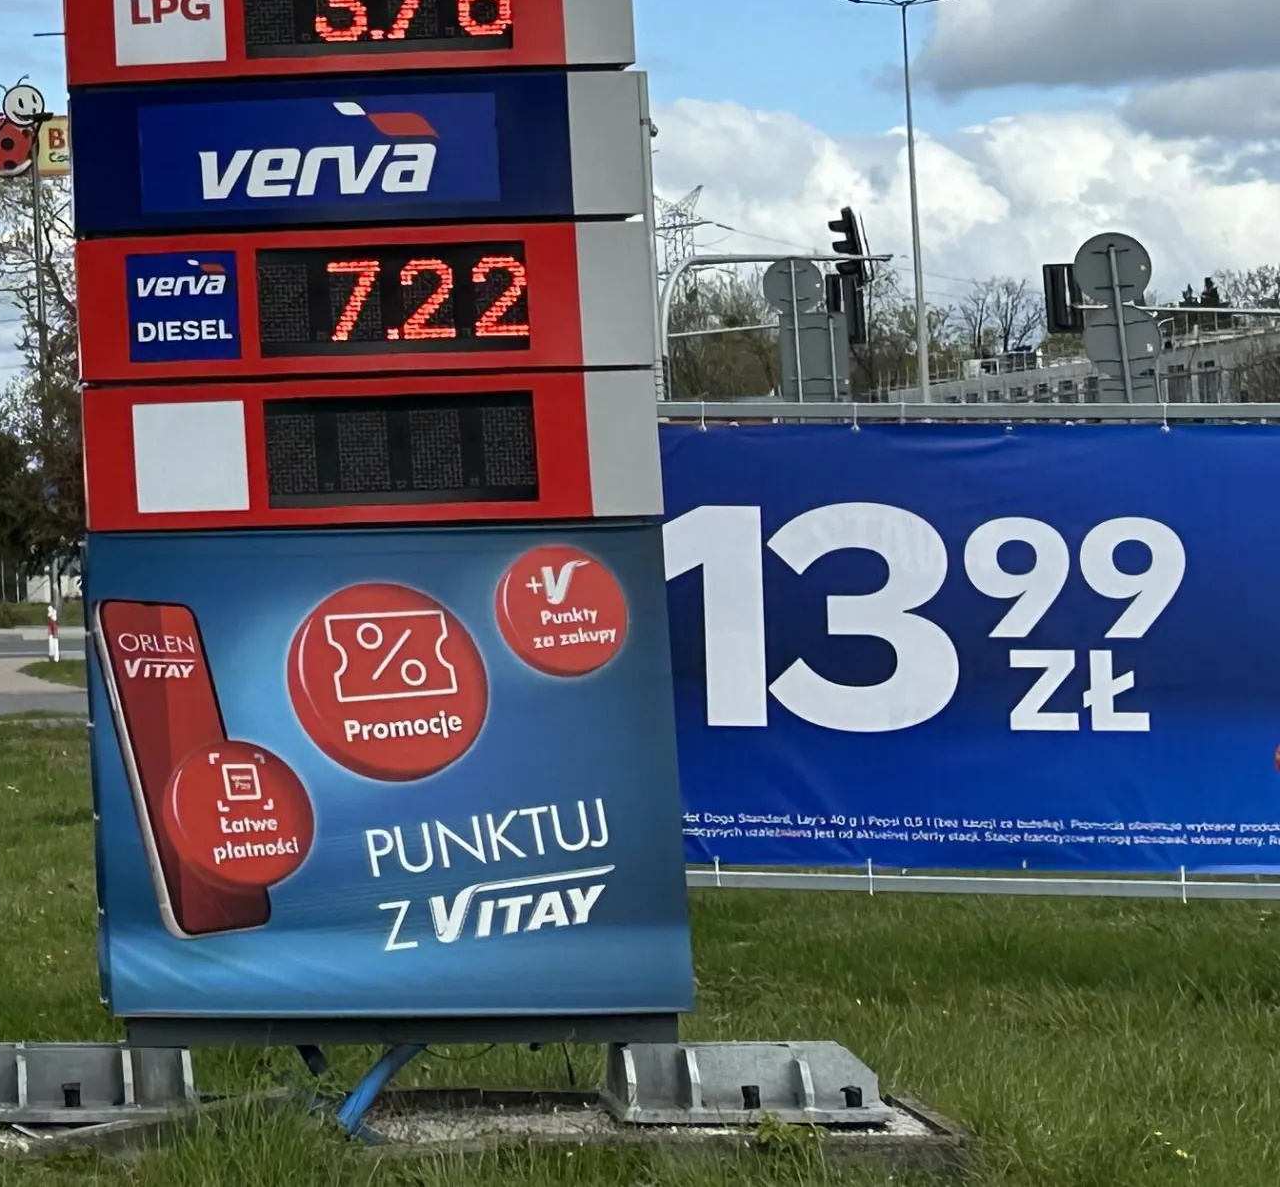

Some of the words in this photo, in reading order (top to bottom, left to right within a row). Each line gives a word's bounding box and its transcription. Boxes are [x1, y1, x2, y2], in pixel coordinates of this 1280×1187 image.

[199, 141, 438, 200] verva
[136, 273, 226, 297] verva
[327, 256, 529, 342] 7.22
[137, 319, 233, 343] DIESEL
[540, 607, 598, 626] Punkty
[118, 632, 195, 655] ORLEN
[533, 635, 555, 649] za
[559, 626, 617, 647] zakupy
[123, 658, 195, 680] VITAY
[1010, 649, 1150, 731] ZŁ
[344, 710, 463, 742] Promocje
[366, 798, 609, 877] PUNKTUJ
[429, 865, 615, 943] VITAY
